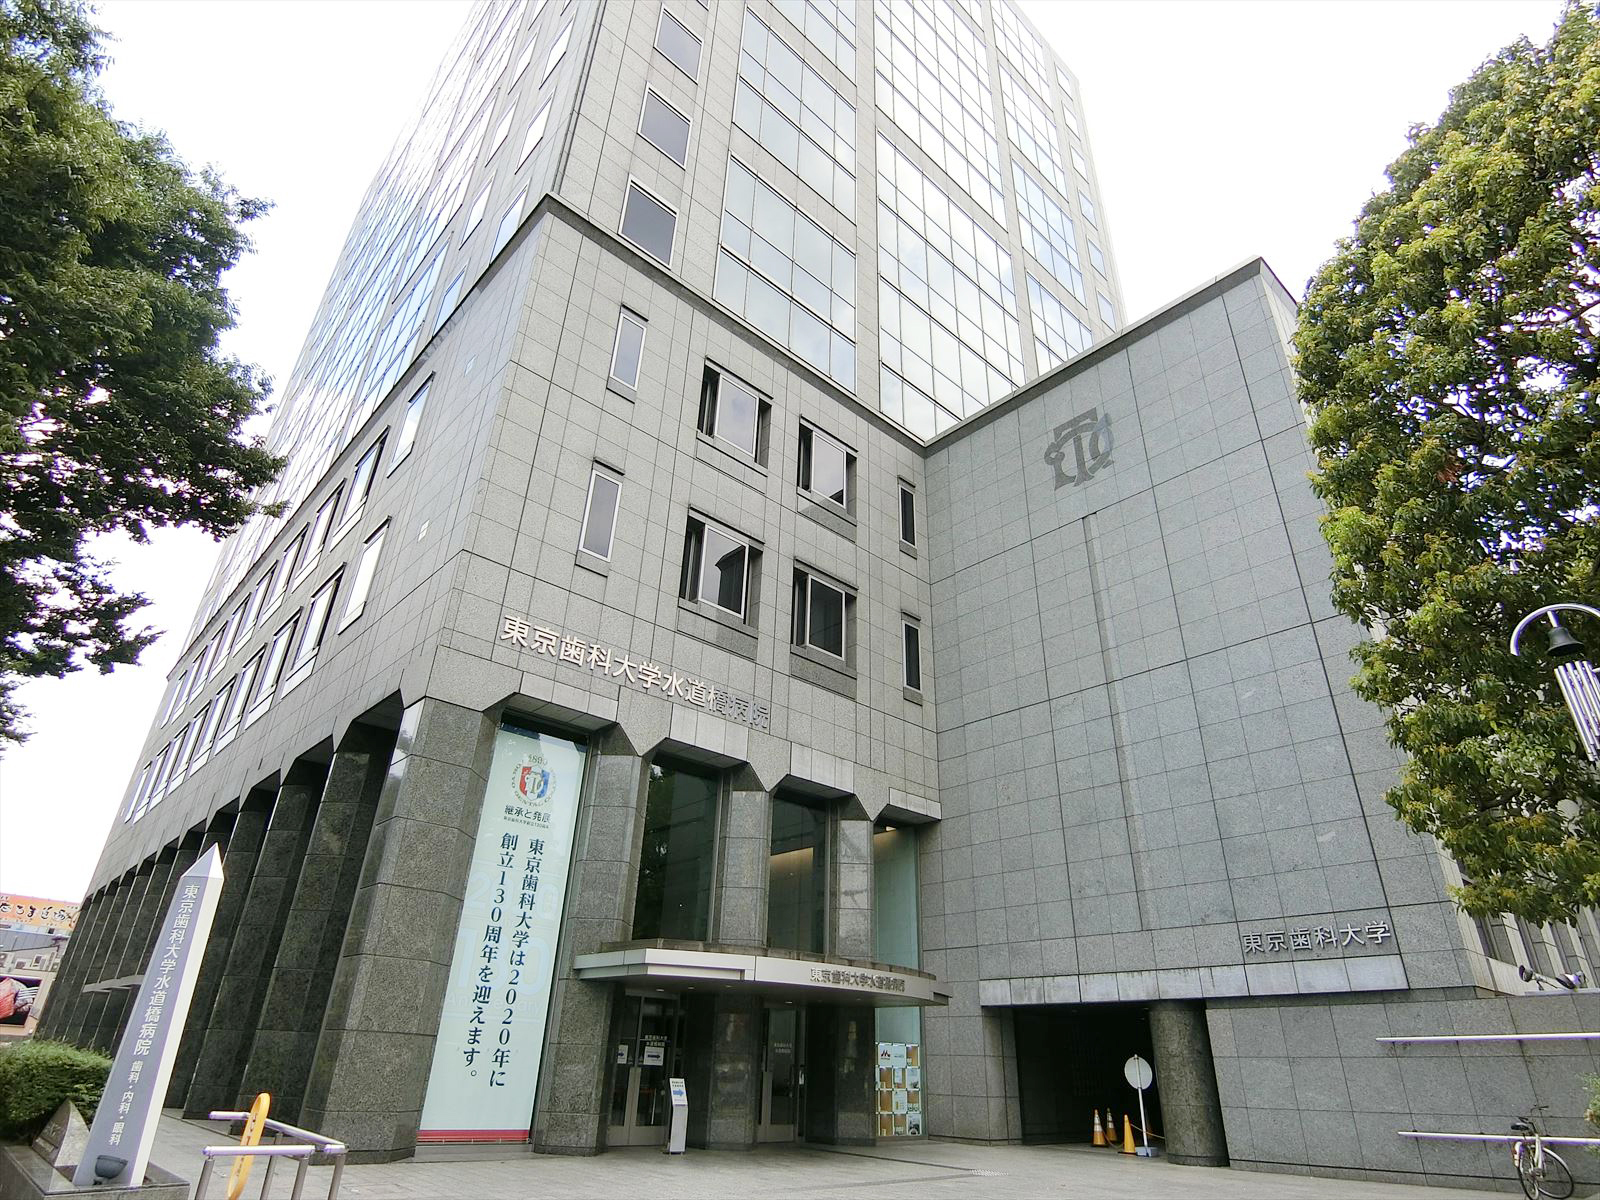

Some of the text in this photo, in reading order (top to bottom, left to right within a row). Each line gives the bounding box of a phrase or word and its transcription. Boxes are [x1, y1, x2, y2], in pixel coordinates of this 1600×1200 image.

[500, 613, 769, 730] 東京歯科大学水道橋病院
[133, 885, 200, 1056] 東京歯科大学水道橋病院
[463, 832, 519, 1077] 創立130周年を迎えます。
[489, 838, 545, 1087] 東京歯科大学は2020年に
[1242, 920, 1390, 954] 東京歯科大学
